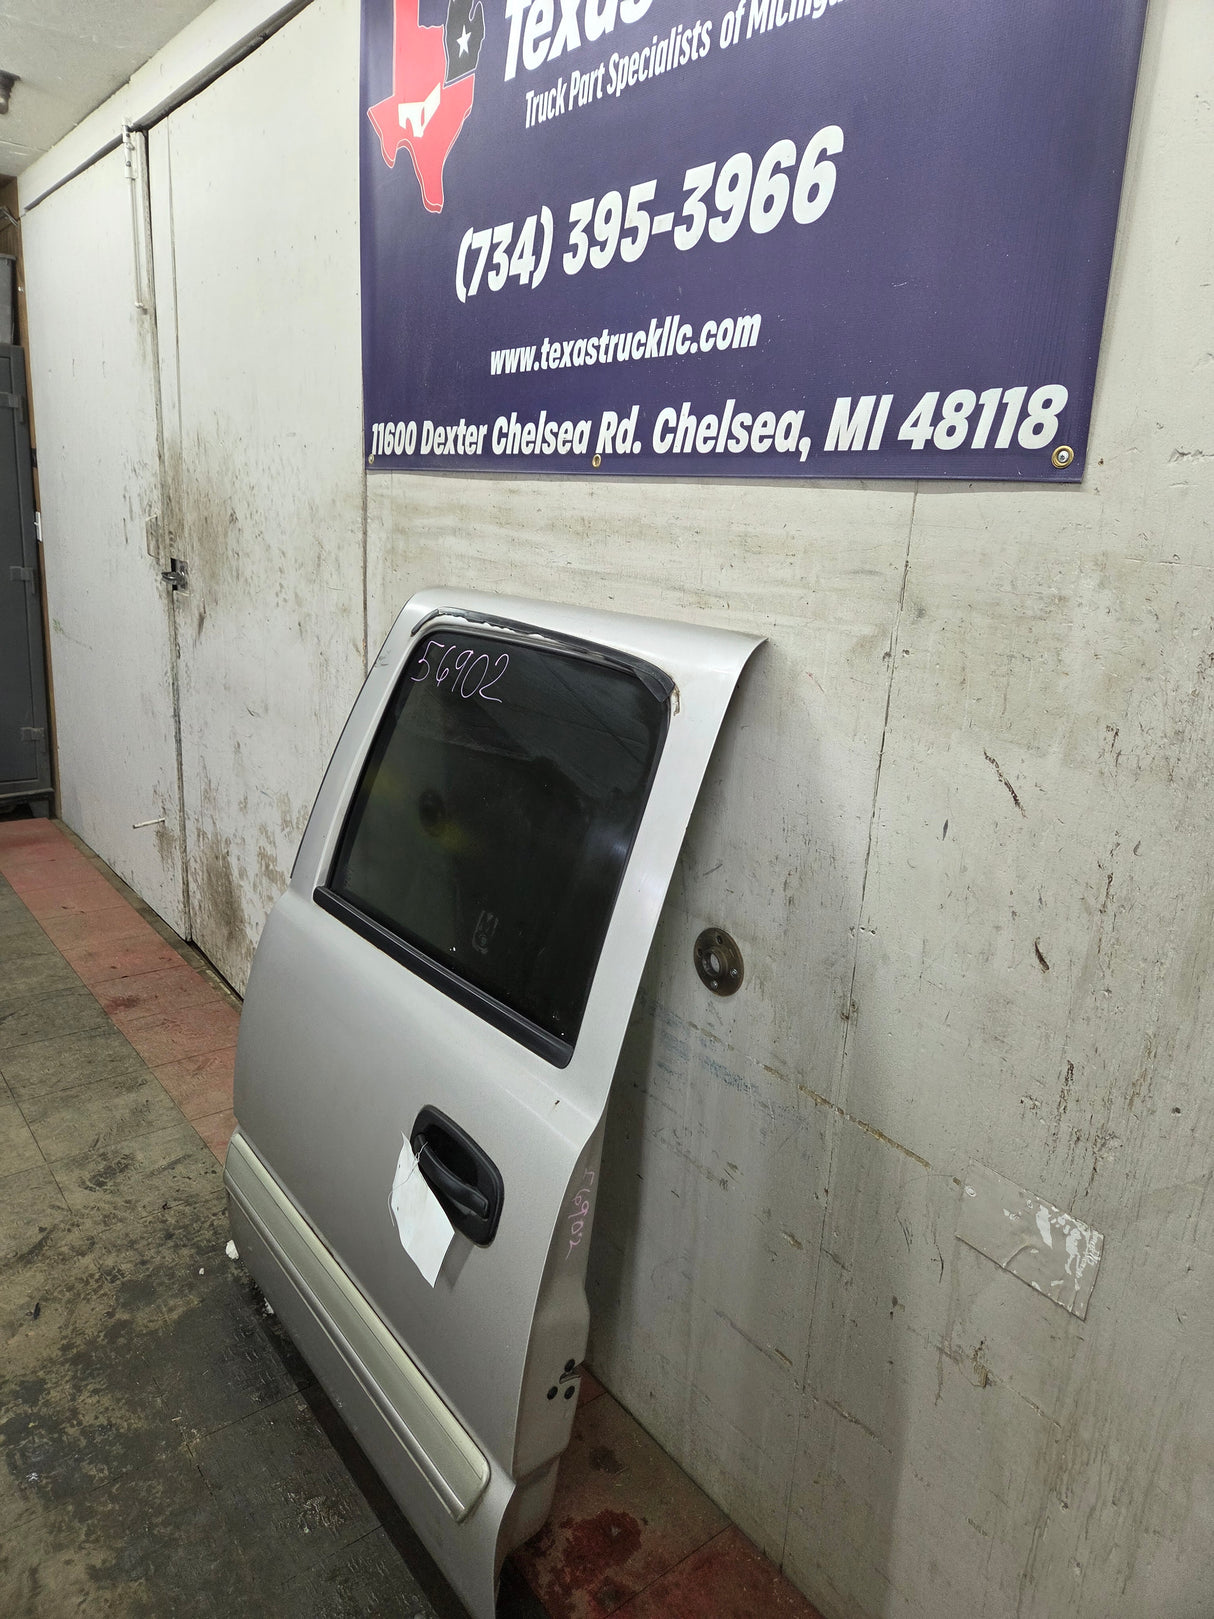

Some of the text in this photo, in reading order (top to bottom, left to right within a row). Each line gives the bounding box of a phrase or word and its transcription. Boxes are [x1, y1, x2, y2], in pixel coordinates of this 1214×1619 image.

[525, 77, 568, 129] Truck
[568, 62, 605, 111] Part
[606, 20, 713, 97] Specialists
[719, 0, 746, 49] of
[455, 125, 844, 303] (734) 395-3966
[490, 313, 762, 375] www.texastruckllc.com
[371, 384, 1070, 462] 11600 Dexter Chelsea Rd. Chelsea, MI 48118
[410, 640, 510, 703] 56902
